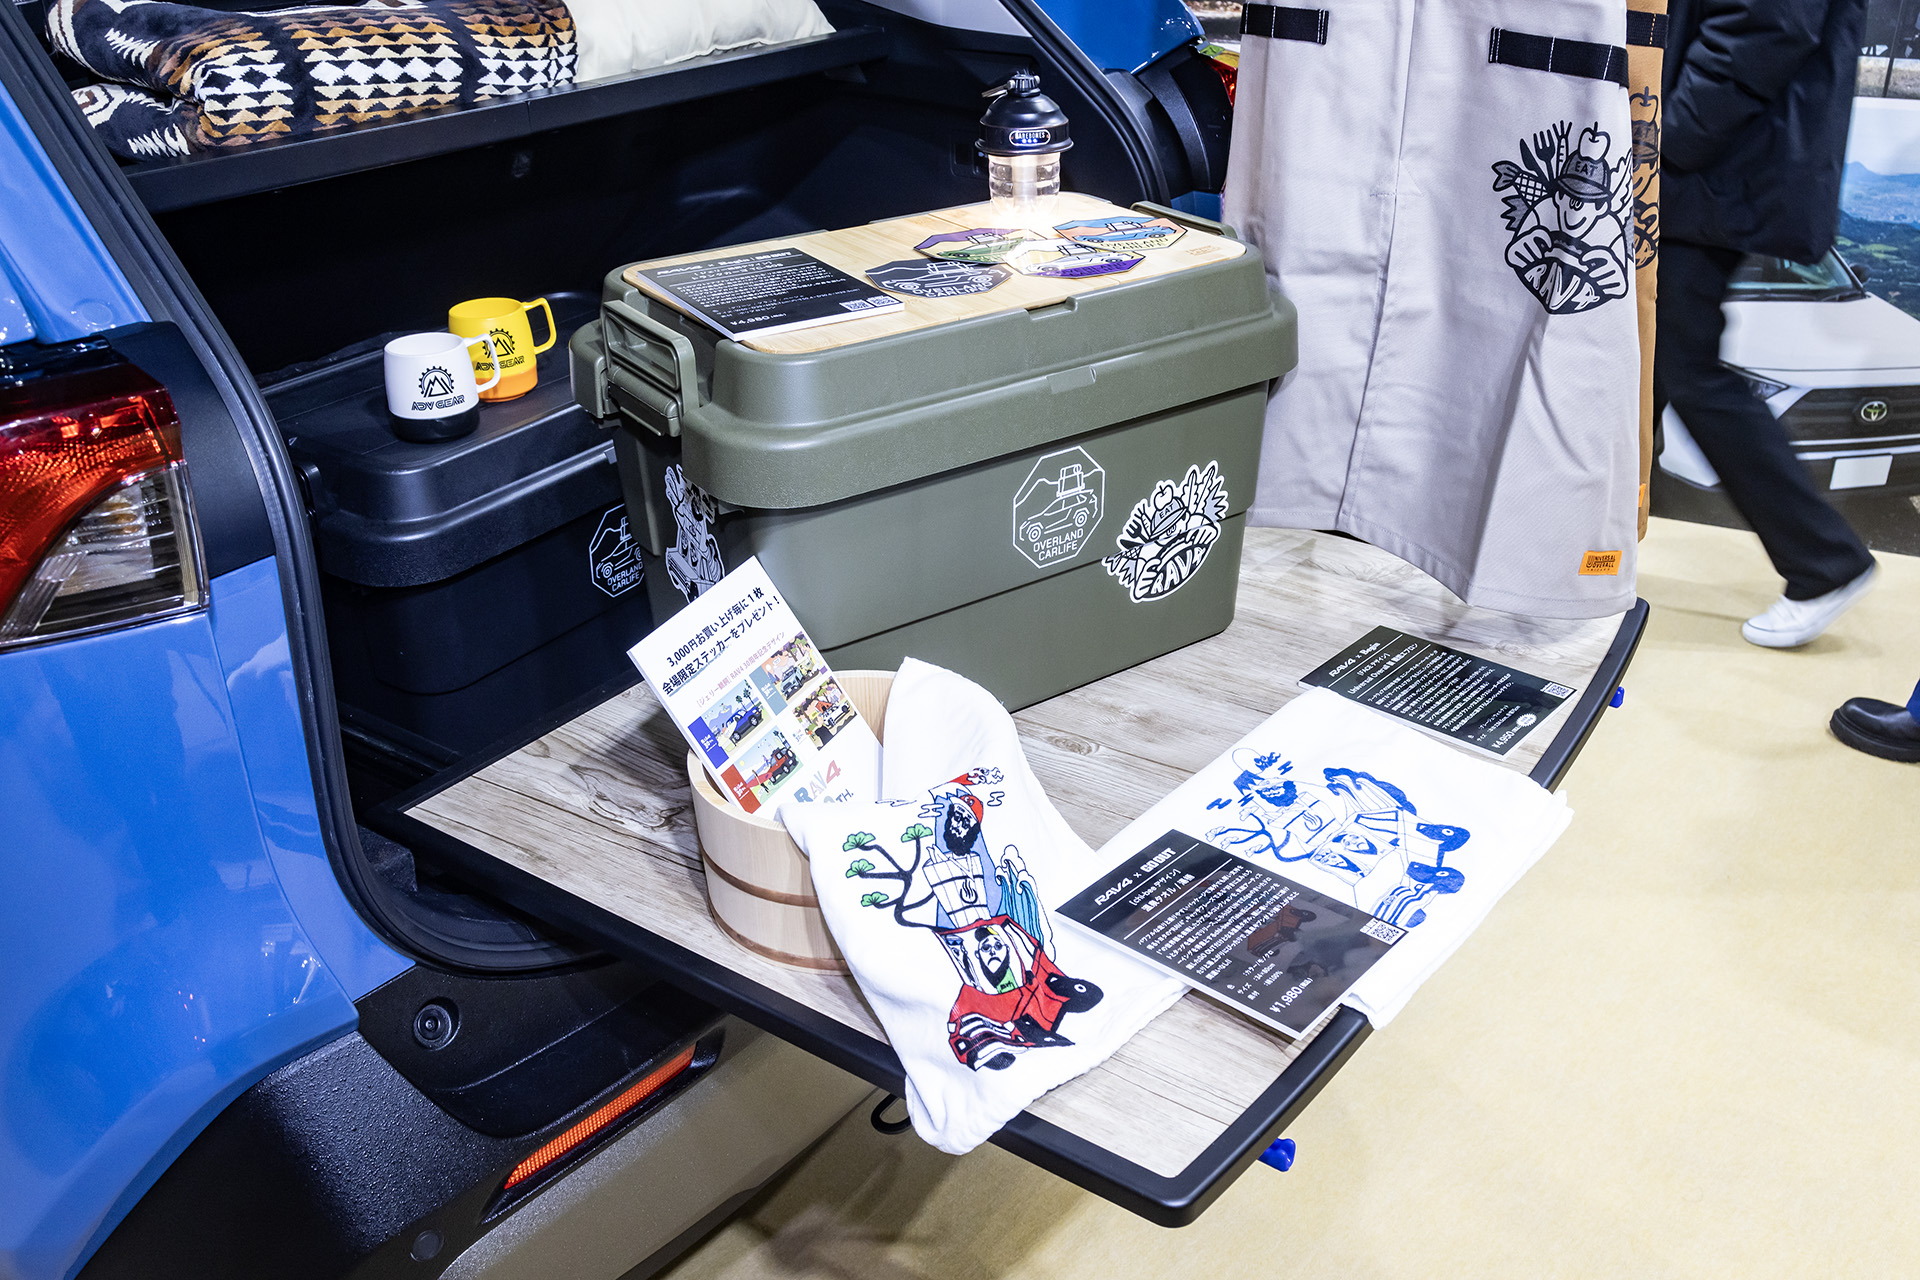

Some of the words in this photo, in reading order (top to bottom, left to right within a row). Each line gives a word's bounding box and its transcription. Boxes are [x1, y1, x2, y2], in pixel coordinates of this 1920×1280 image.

[1574, 160, 1599, 176] EAT
[913, 281, 993, 295] OVERLAND
[411, 400, 435, 411] ADV
[435, 394, 465, 409] GEAR
[1159, 503, 1175, 519] EAT
[1033, 528, 1084, 552] OVERLAND
[1038, 540, 1078, 561] CARLIFE
[607, 563, 643, 586] OVERLAND
[611, 573, 640, 592] CARLIFE
[1328, 657, 1356, 677] RAV4
[1358, 642, 1380, 655] Begin
[729, 665, 744, 679] RAV4
[1491, 730, 1514, 748] ¥4,950
[1094, 877, 1133, 905] RAV4
[1236, 981, 1252, 994] サイズ
